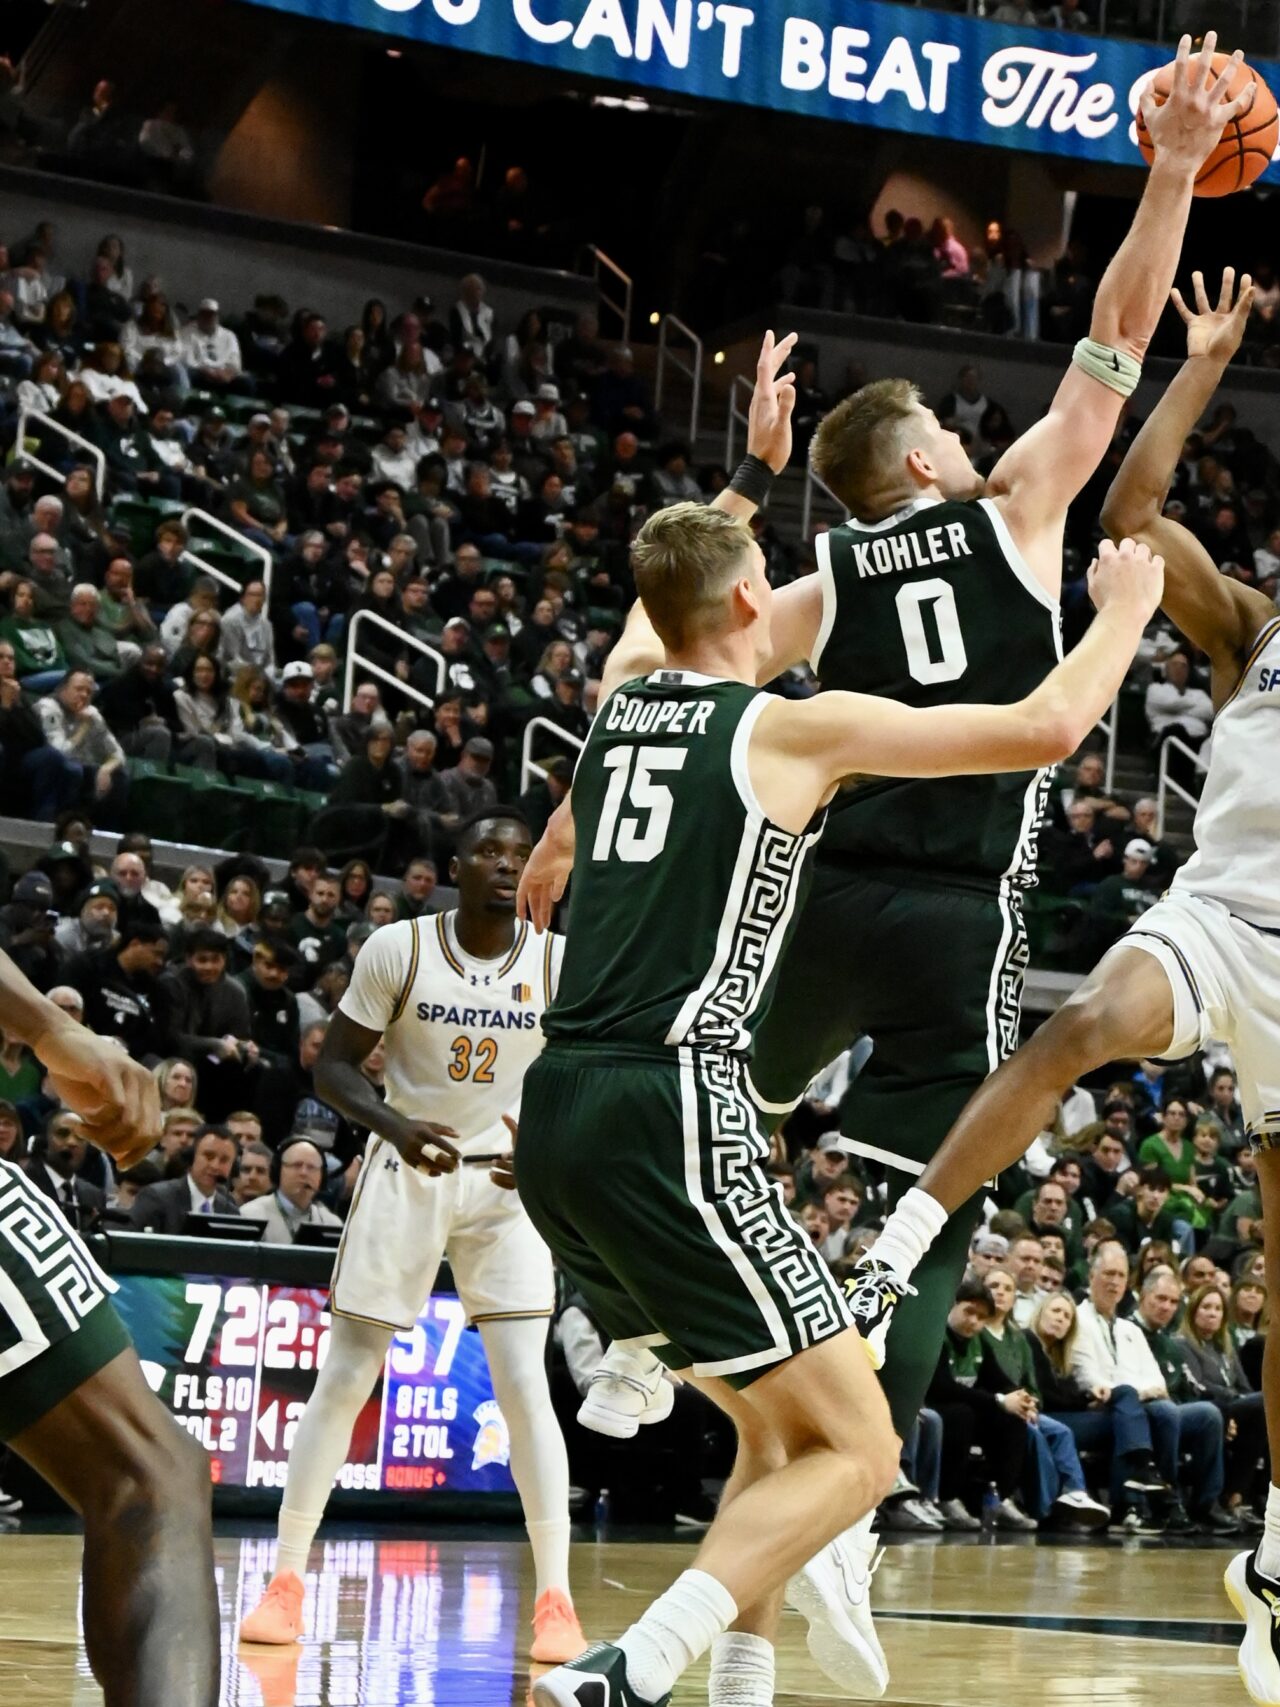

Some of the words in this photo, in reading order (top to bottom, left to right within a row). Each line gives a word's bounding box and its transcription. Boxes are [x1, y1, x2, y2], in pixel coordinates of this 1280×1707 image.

[780, 16, 961, 114] BEAT
[981, 46, 1120, 139] The
[851, 521, 973, 579] KOHLER
[894, 577, 969, 686] 0
[605, 692, 716, 736] COOPER
[592, 745, 689, 863] 15
[416, 1002, 537, 1031] SPARTANS
[447, 1034, 498, 1083] 32
[184, 1283, 260, 1366] 72
